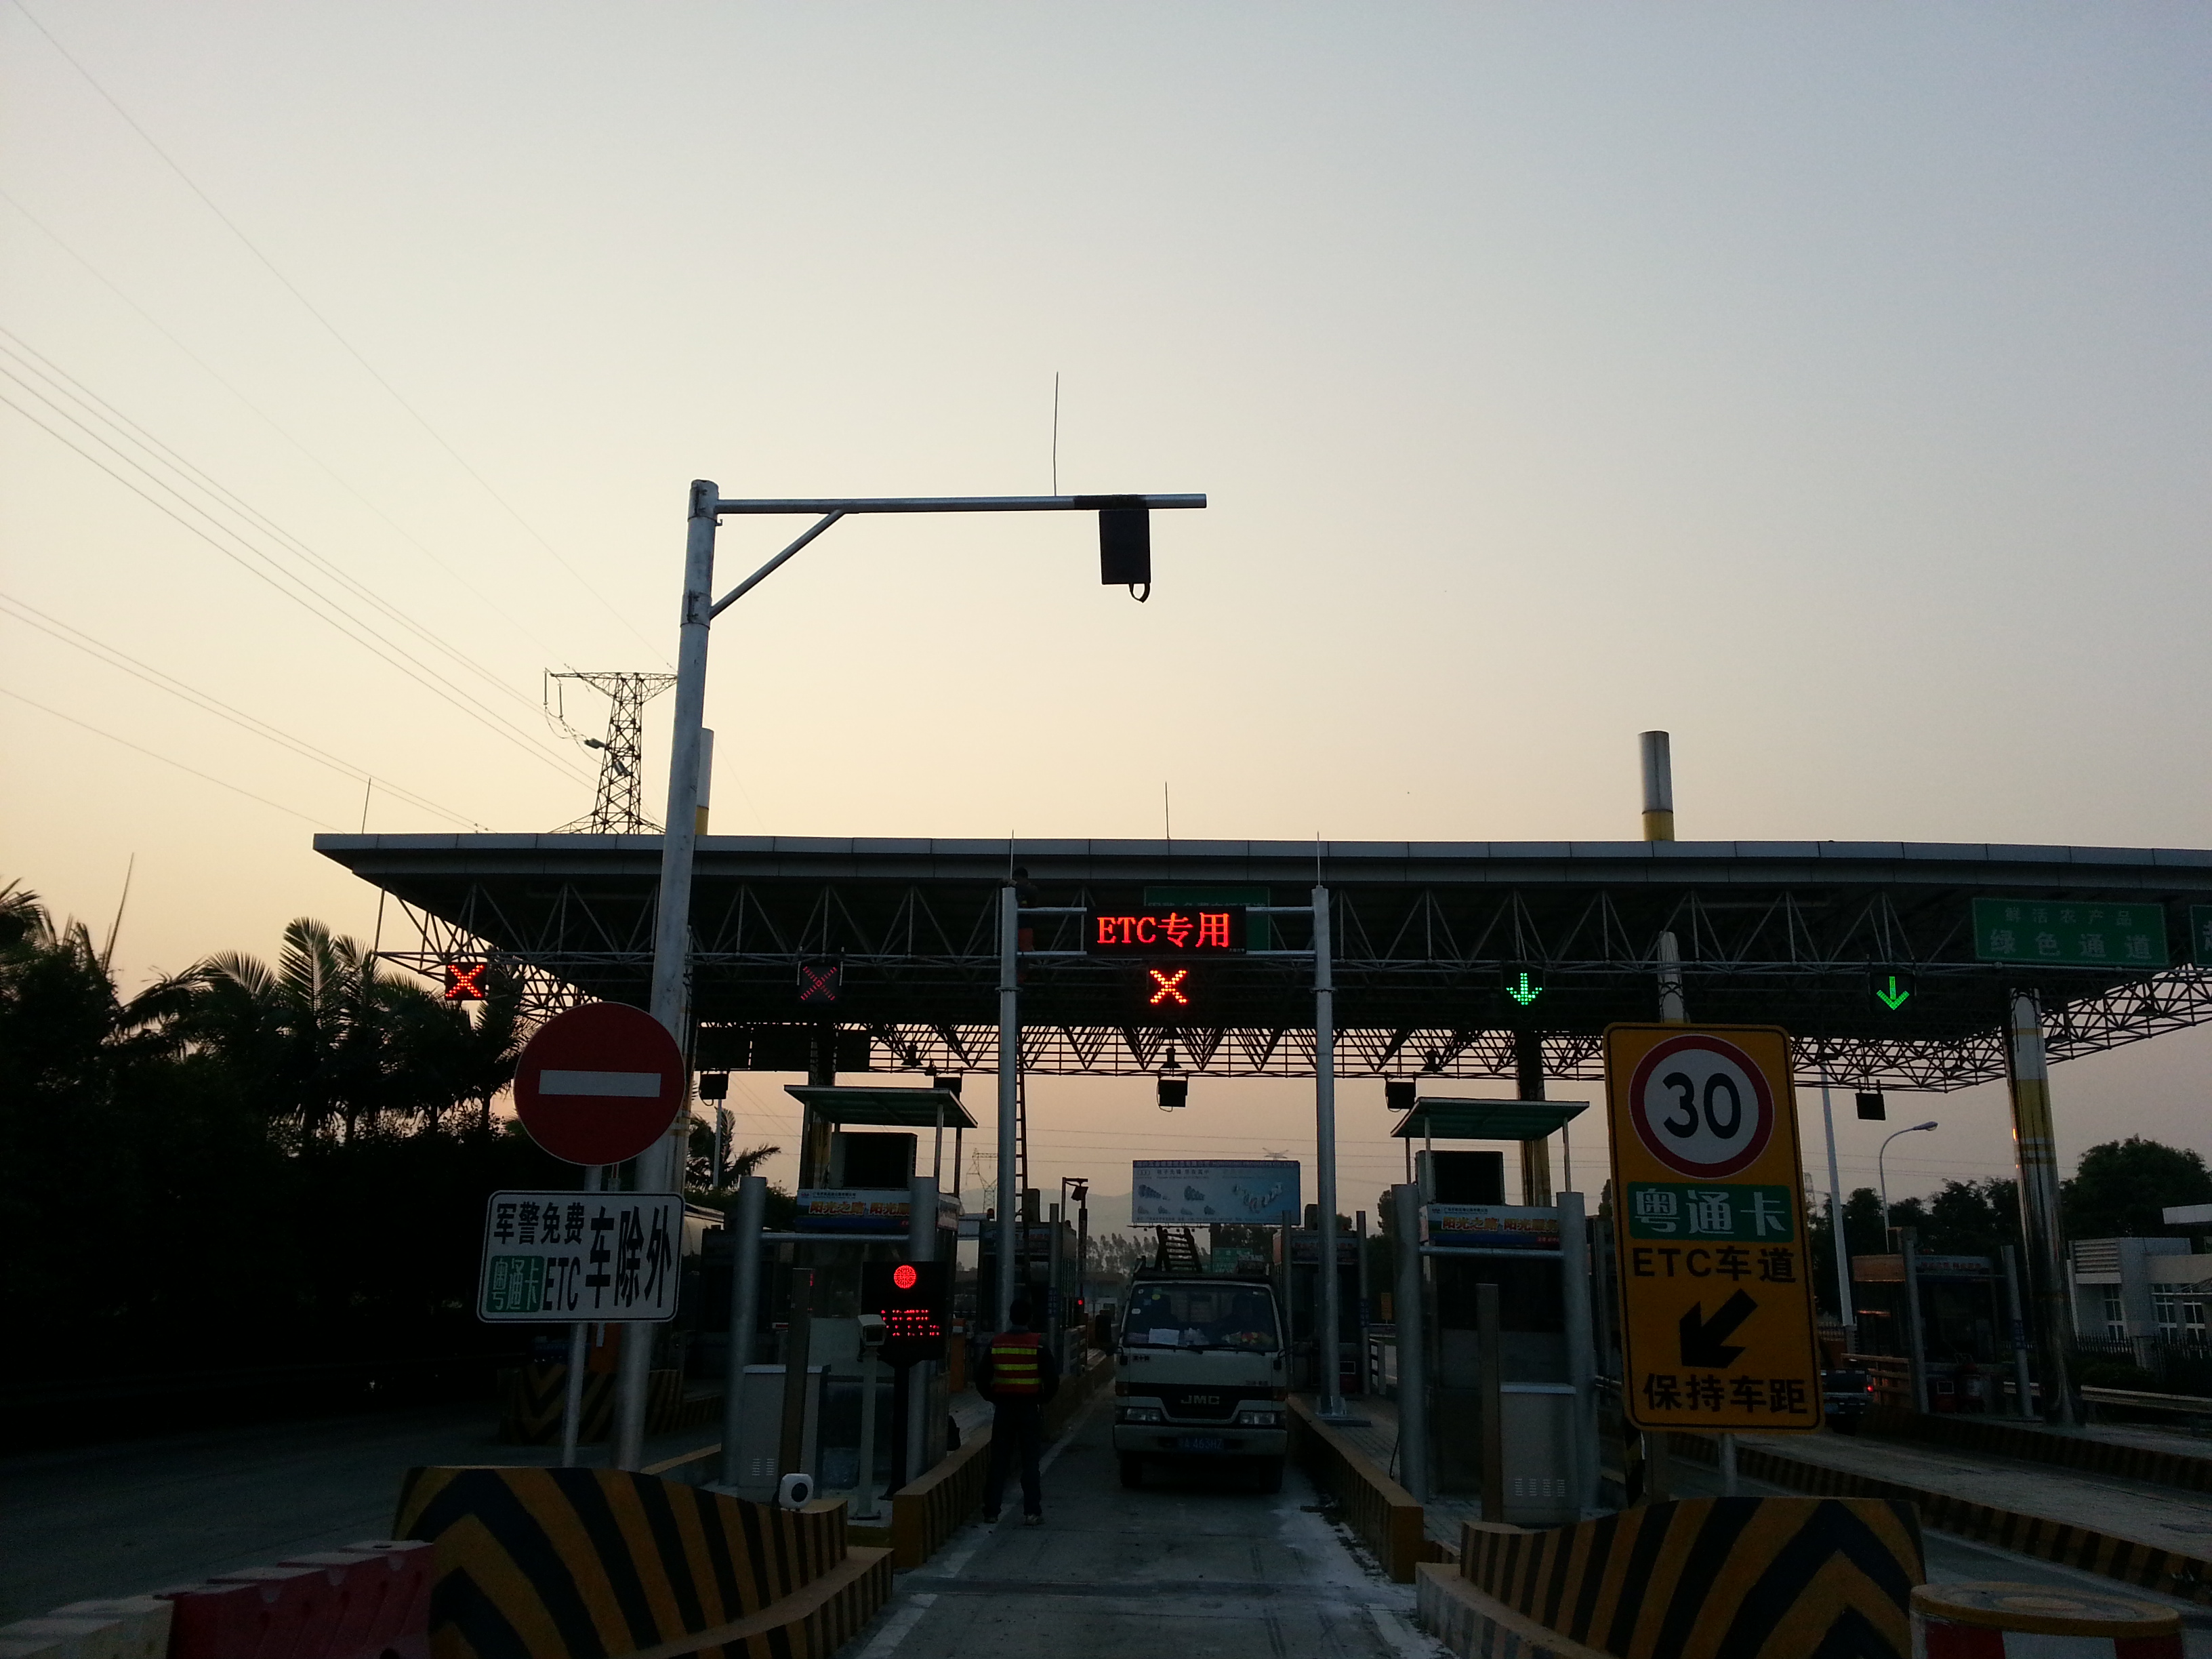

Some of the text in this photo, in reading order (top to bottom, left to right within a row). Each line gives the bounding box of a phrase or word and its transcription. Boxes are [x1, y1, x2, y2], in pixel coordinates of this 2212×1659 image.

[1097, 912, 1230, 947] ETC专用
[1990, 928, 2152, 959] 绿色通道
[1662, 1072, 1742, 1139] 30
[493, 1202, 585, 1244] 军警免费
[1634, 1188, 1787, 1236] 粤通卡
[586, 1205, 672, 1309] 车除外
[1633, 1245, 1796, 1283] ETC车道
[491, 1256, 581, 1311] 粤通卡 ETC
[1180, 1395, 1220, 1405] JMC
[1643, 1373, 1808, 1414] 保持车距
